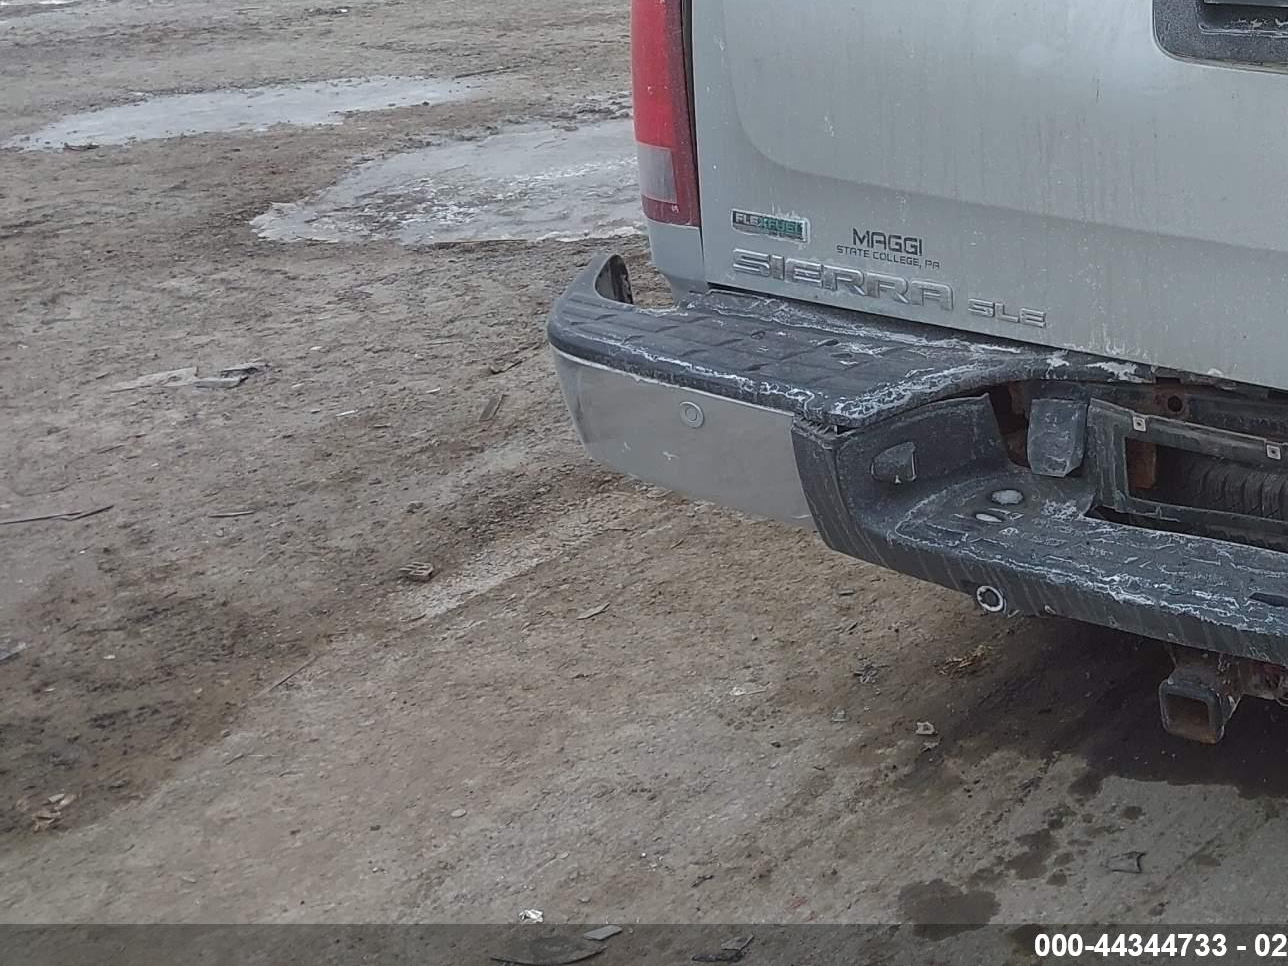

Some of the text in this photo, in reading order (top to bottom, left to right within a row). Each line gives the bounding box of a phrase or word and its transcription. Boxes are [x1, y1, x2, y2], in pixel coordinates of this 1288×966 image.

[852, 227, 923, 257] MAGGI
[836, 245, 940, 270] STATE COLLEGE, PA
[732, 248, 1047, 328] SIERRA SLE
